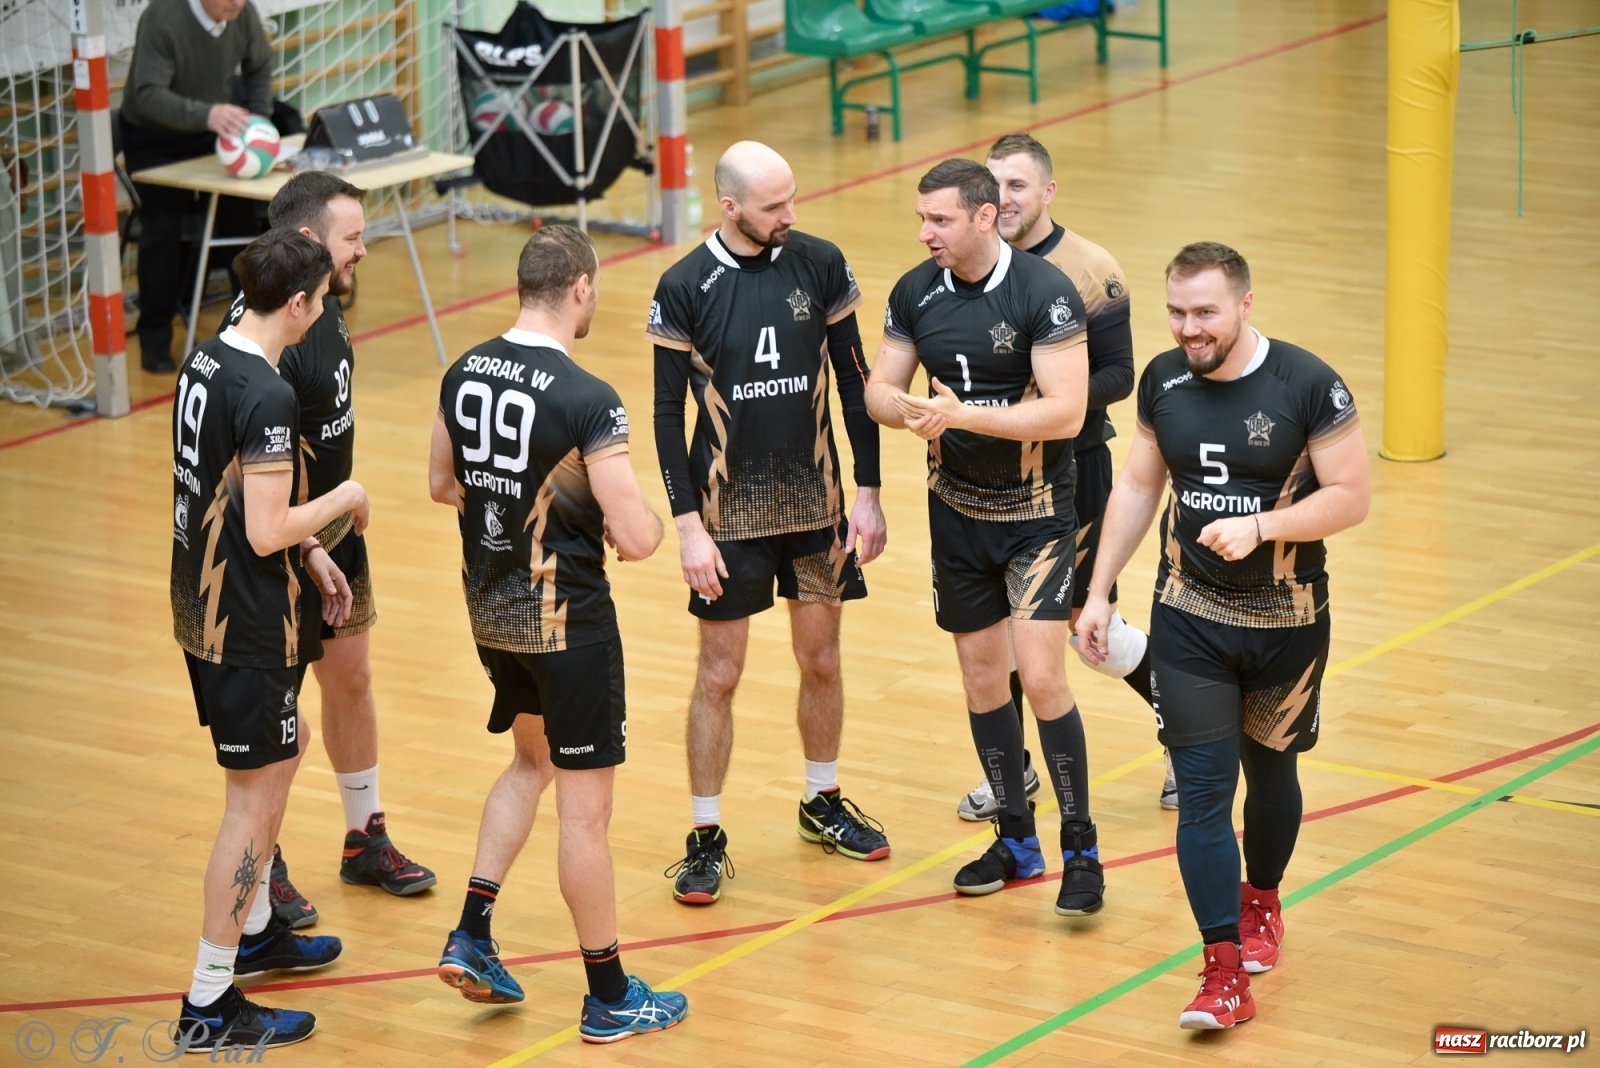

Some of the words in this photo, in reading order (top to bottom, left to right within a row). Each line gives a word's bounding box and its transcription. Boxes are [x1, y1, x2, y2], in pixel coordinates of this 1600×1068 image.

[754, 326, 781, 370] 4
[191, 350, 221, 380] BART
[530, 368, 555, 391] W
[956, 354, 972, 391] 1
[334, 358, 351, 408] 10
[732, 375, 809, 401] AGROTIM
[177, 372, 208, 467] 19
[265, 426, 286, 435] DARK
[455, 380, 536, 473] 99
[1199, 443, 1229, 485] 5
[1181, 490, 1261, 513] AGROTIM
[280, 716, 296, 745] 19
[219, 743, 250, 753] AGROTIM
[559, 744, 595, 755] AGROTIM
